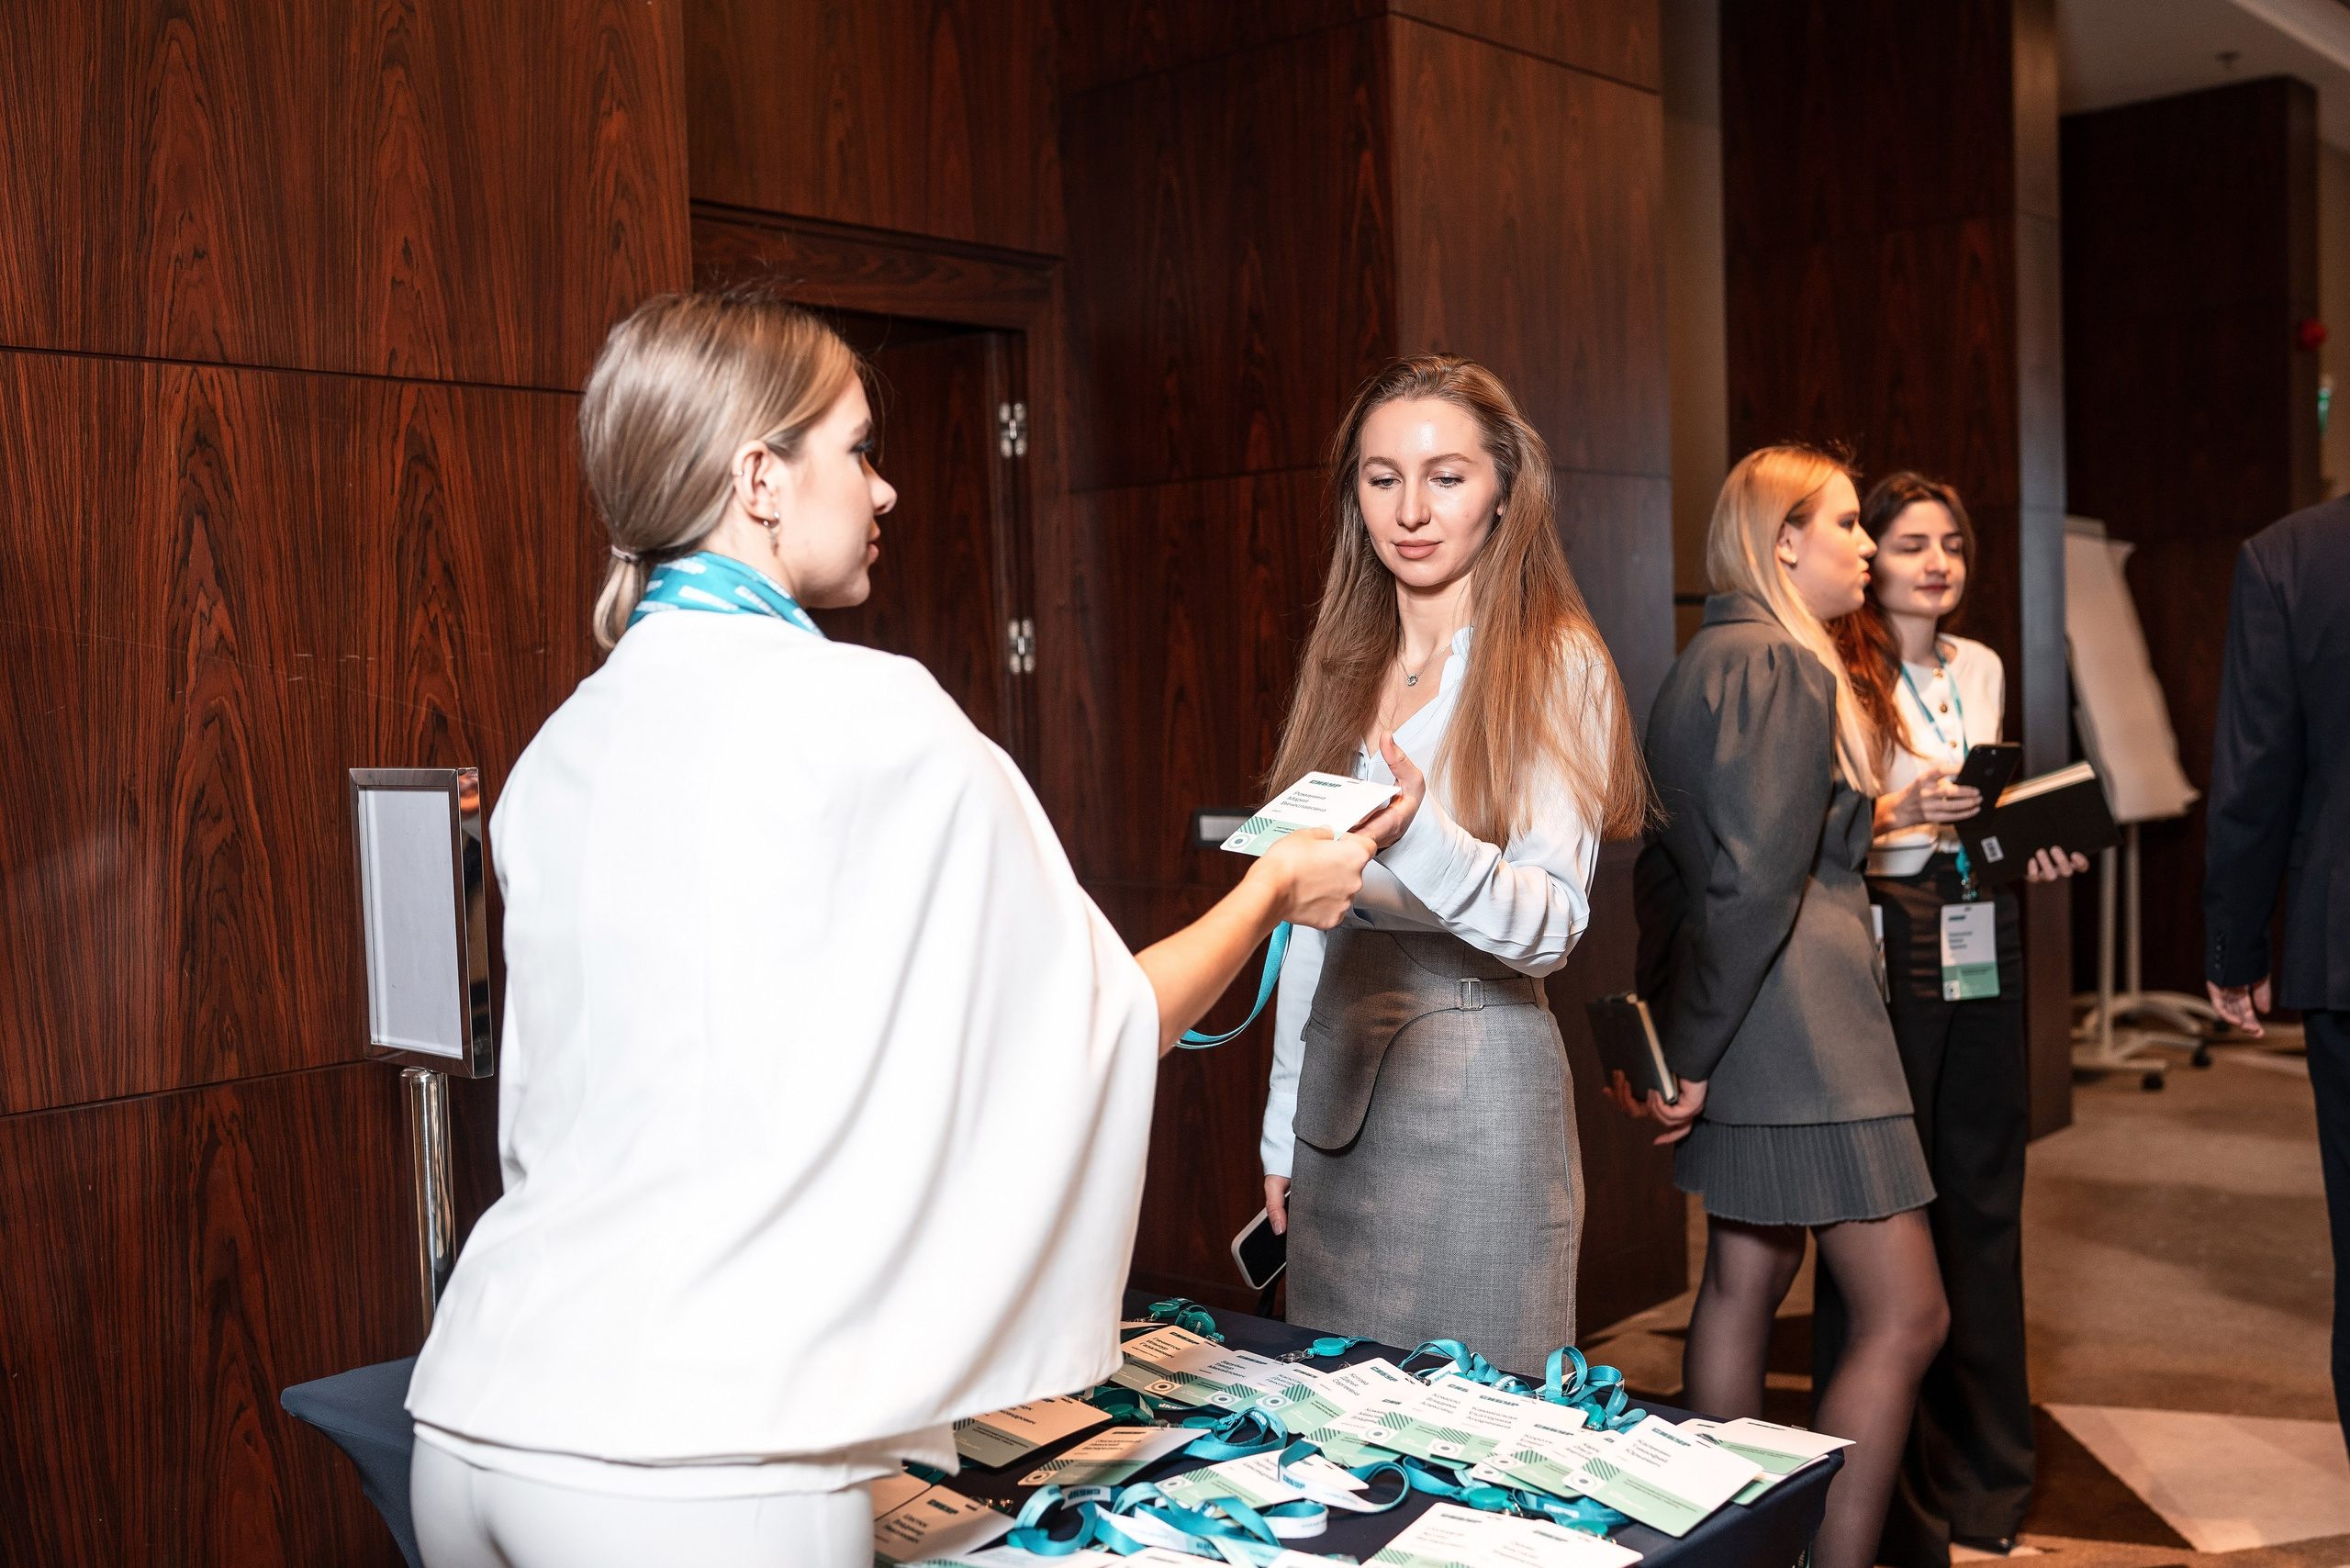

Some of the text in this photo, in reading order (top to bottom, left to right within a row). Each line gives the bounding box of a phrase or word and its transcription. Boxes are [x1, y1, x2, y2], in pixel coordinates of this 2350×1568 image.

[1309, 779, 1342, 788] СИБУР
[1287, 796, 1309, 804] Мария
[1370, 1366, 1398, 1383] СИБУР
[1479, 1394, 1520, 1406] СИБУР
[1651, 1428, 1691, 1447] СИБУР
